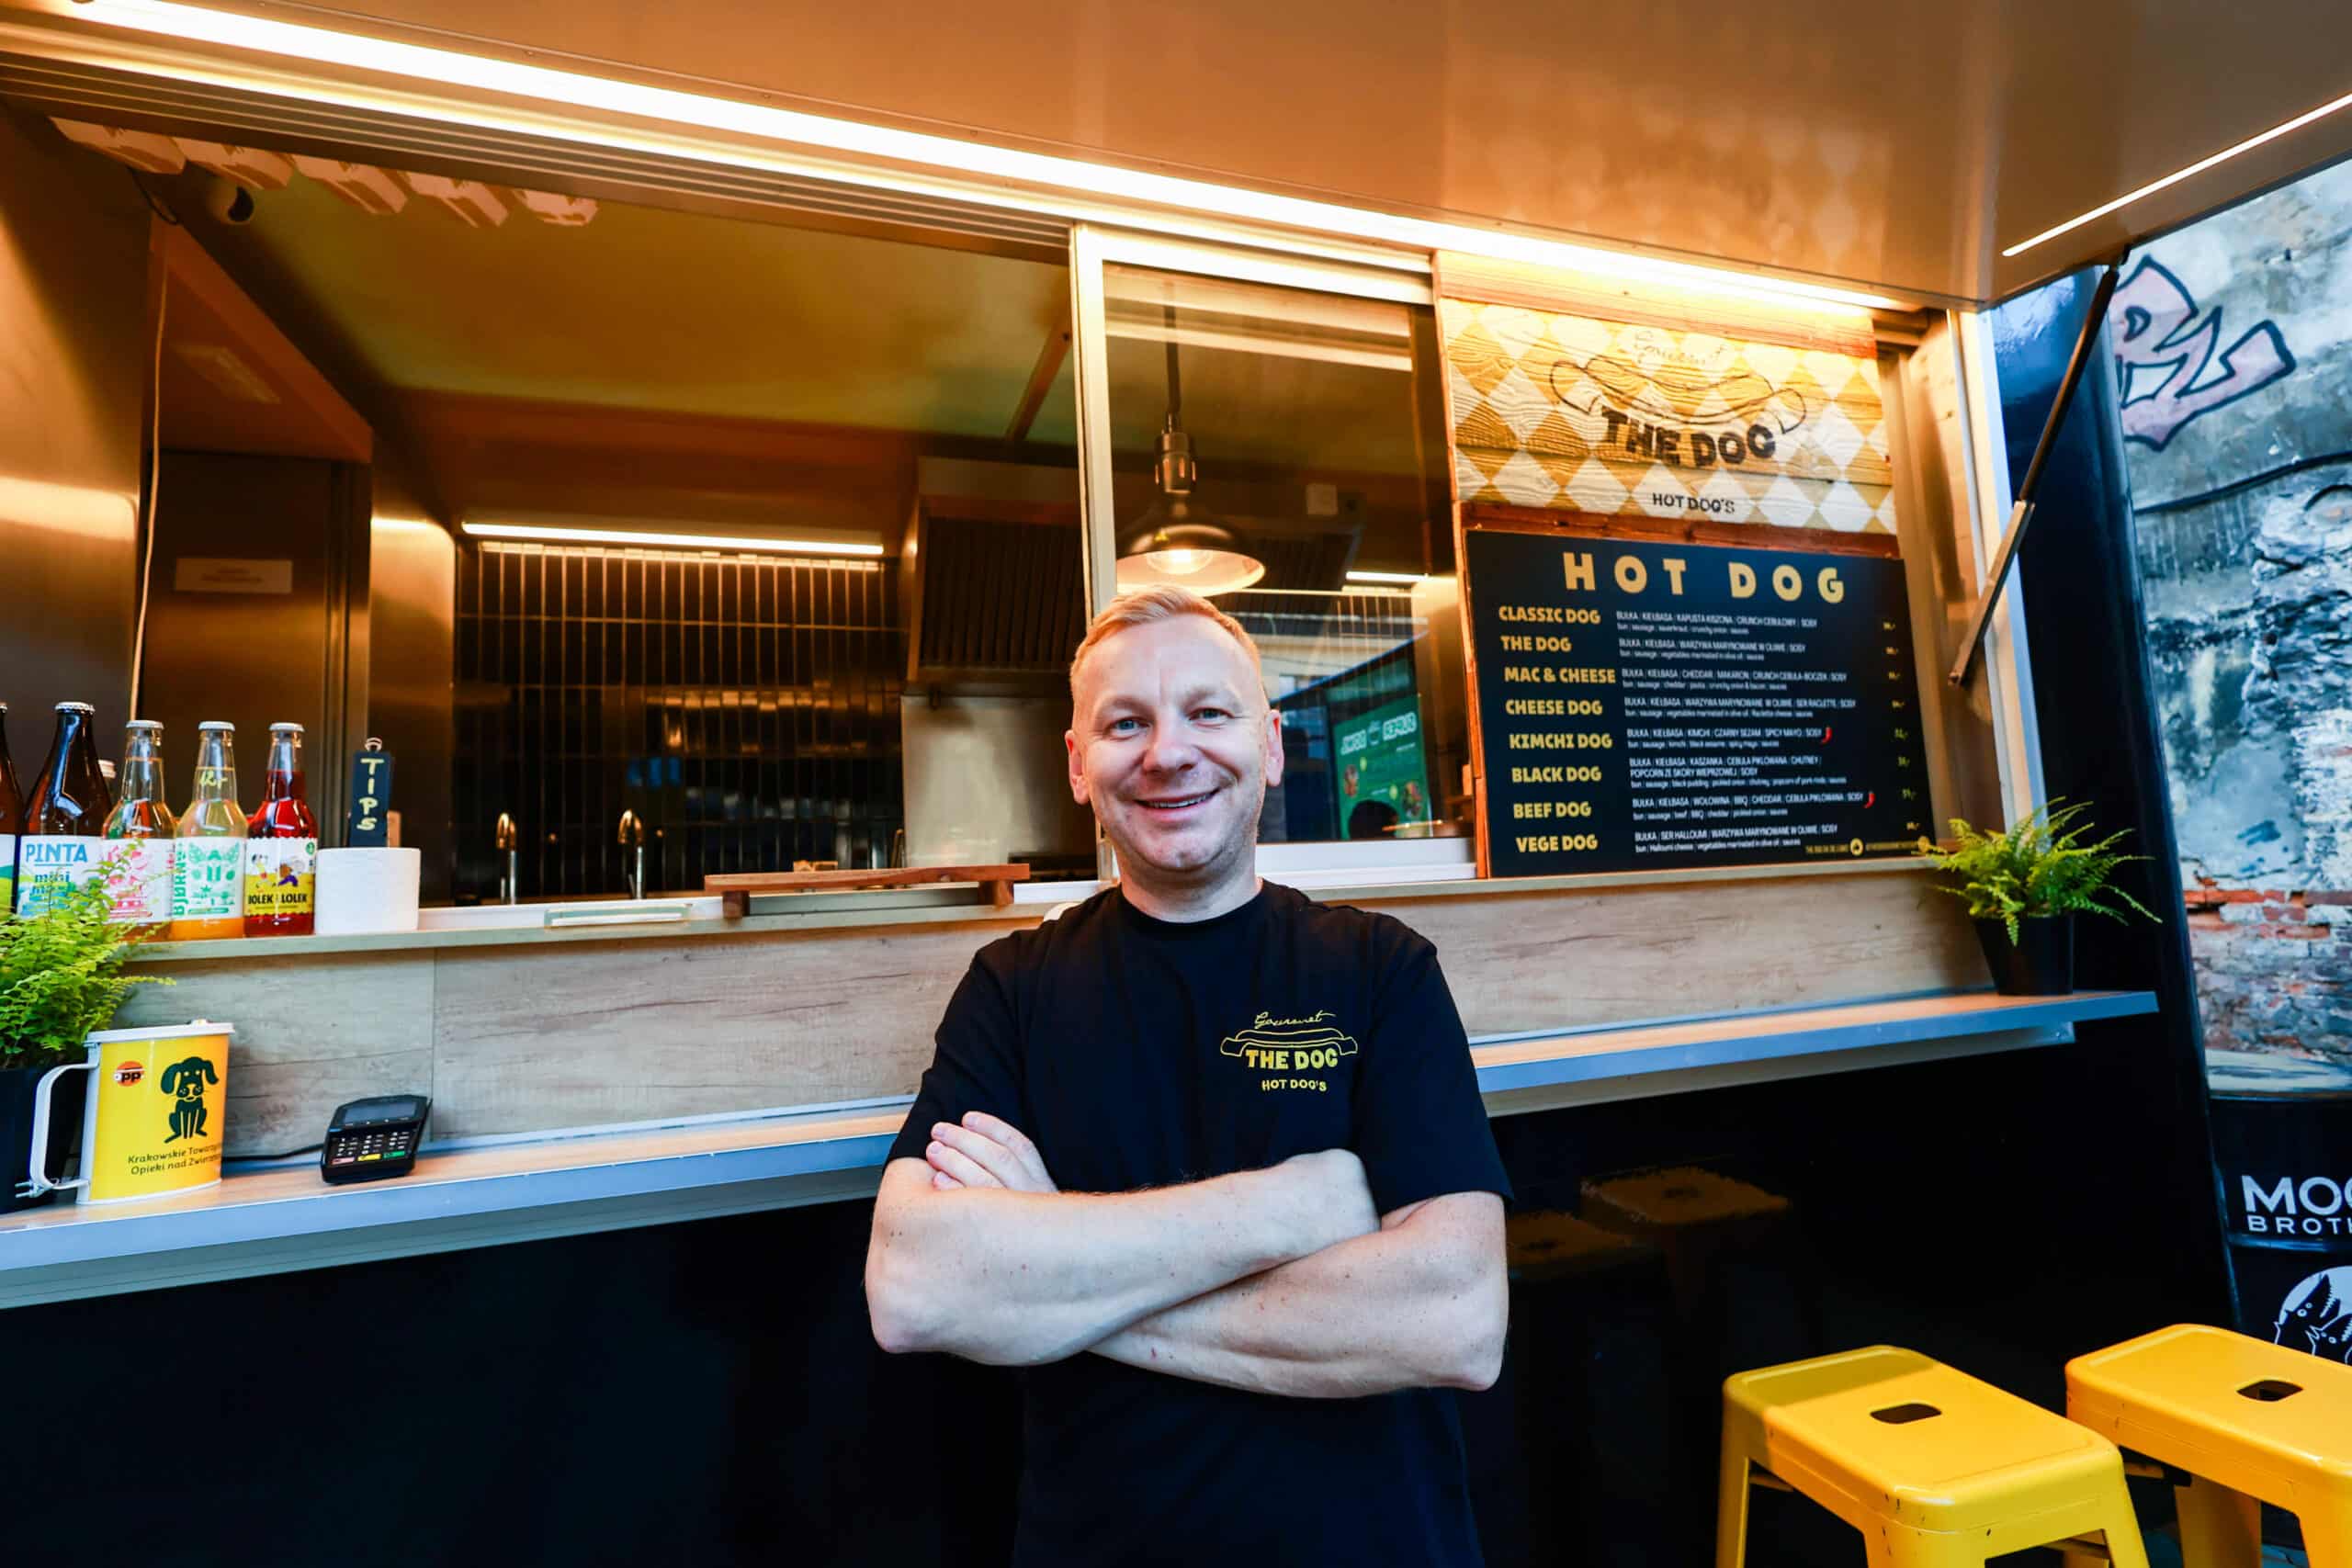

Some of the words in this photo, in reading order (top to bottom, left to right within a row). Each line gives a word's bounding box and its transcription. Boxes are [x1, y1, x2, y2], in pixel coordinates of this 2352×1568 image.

[1600, 408, 1680, 466] THE
[1691, 423, 1776, 467] DOG
[1652, 492, 1685, 513] HOT
[1688, 496, 1735, 514] DOG'S
[1562, 552, 1687, 595] HOT
[1728, 562, 1845, 604] DOG
[1499, 606, 1564, 624] CLASSIC
[1566, 608, 1601, 626] DOG
[1500, 636, 1532, 652] THE
[1535, 637, 1571, 652] DOG
[1504, 666, 1541, 682] MAC
[1544, 667, 1556, 683] &
[1559, 668, 1616, 684] CHEESE
[1506, 699, 1565, 716] CHEESE
[1566, 700, 1602, 716] DOG
[1510, 733, 1575, 750] KIMCHI
[1577, 733, 1612, 750] DOG
[1511, 766, 1564, 783] BLACK
[1566, 766, 1602, 783] DOG
[1630, 768, 1663, 777] POPCORN
[356, 758, 385, 830] TIPS
[1513, 803, 1553, 820] BEEF
[1555, 801, 1592, 818] DOG
[26, 843, 88, 863] PINTA
[1516, 836, 1560, 853] VEGE
[1562, 834, 1598, 852] DOG
[281, 893, 308, 904] LOLEK
[1254, 1010, 1337, 1030] Gourmet
[1246, 1049, 1289, 1070] THE
[1295, 1047, 1338, 1070] DOG
[1261, 1079, 1287, 1091] HOT
[1290, 1078, 1327, 1092] DOG'S
[128, 1148, 187, 1164] Krakowskie
[130, 1161, 165, 1176] Opieki
[167, 1157, 187, 1169] nad
[2241, 1175, 2352, 1215] MO
